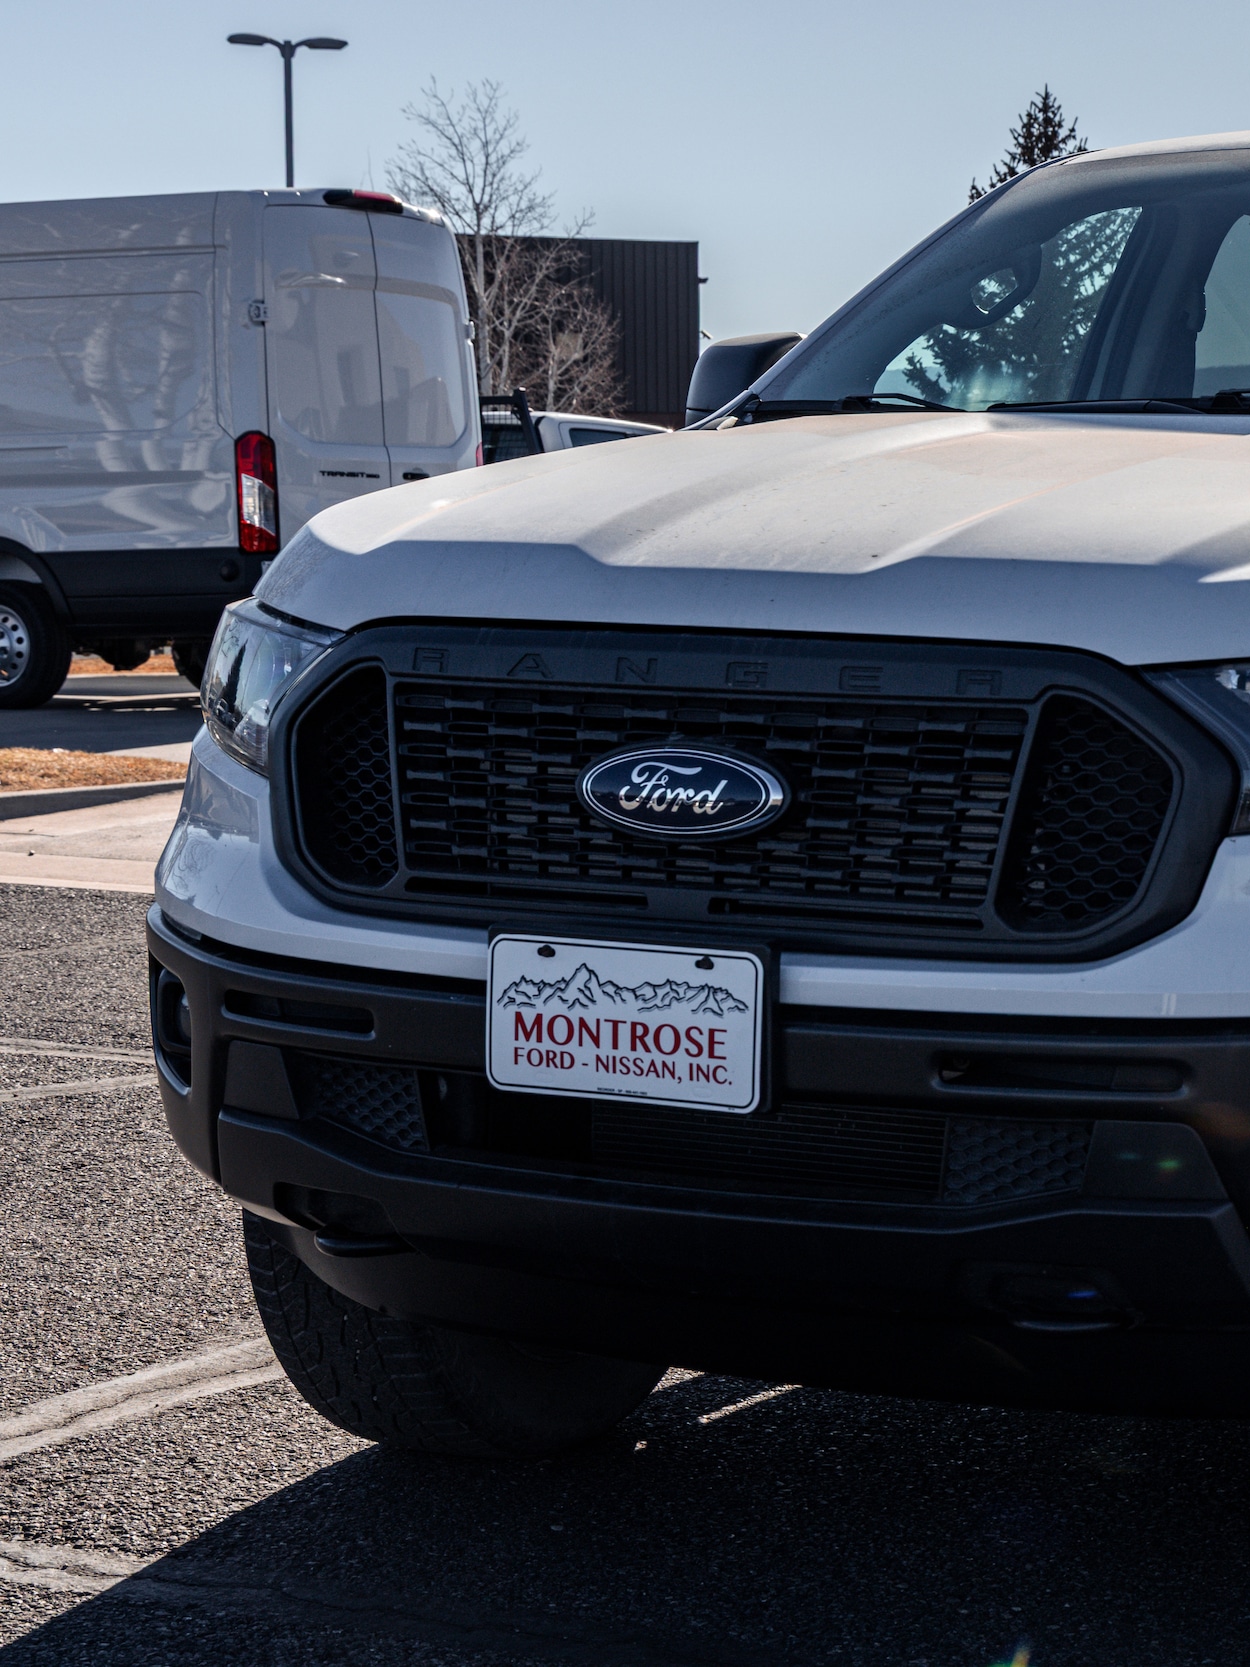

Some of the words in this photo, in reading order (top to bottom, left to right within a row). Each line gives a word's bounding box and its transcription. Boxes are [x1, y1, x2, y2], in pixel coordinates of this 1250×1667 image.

[412, 647, 1002, 696] RANGER
[619, 761, 728, 815] Ford
[513, 1011, 728, 1061] MONTROSE
[513, 1047, 575, 1070] FORD
[595, 1054, 682, 1084] NISSAN,
[688, 1063, 733, 1086] INC.
